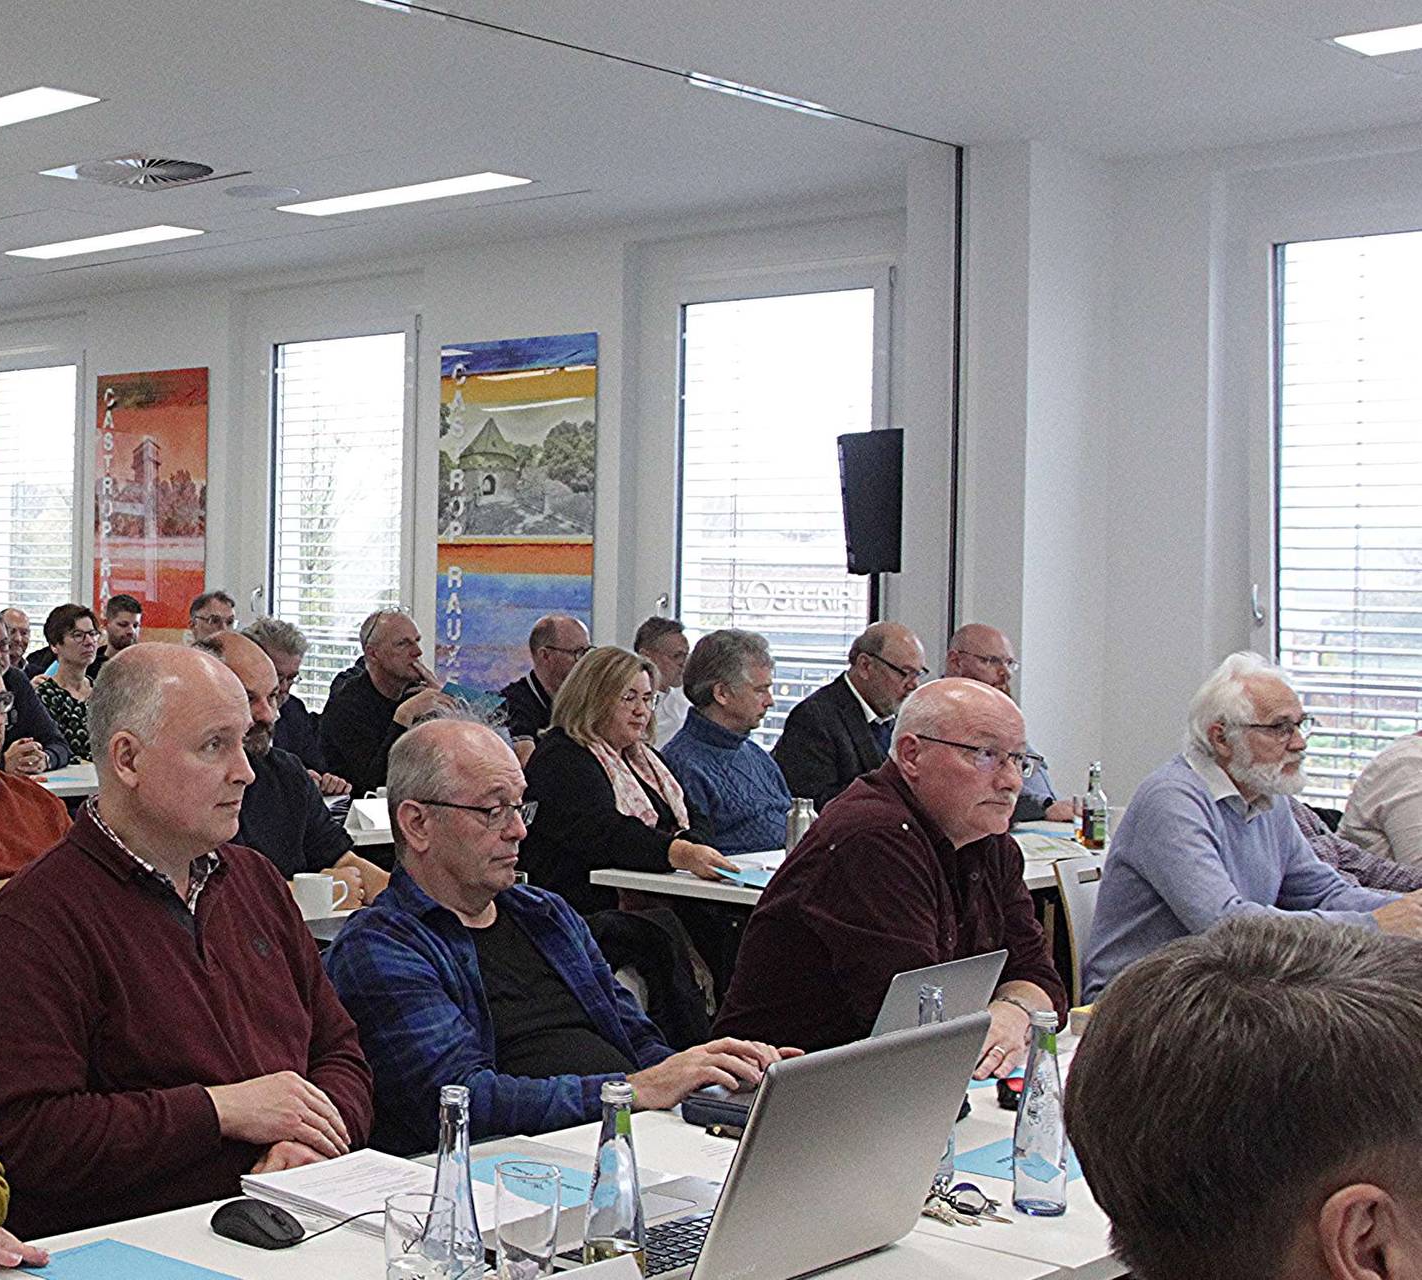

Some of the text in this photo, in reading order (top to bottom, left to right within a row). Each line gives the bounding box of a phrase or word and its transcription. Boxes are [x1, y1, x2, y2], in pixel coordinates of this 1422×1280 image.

[100, 386, 116, 539] CASTROP
[446, 361, 468, 683] CASROP RAUX
